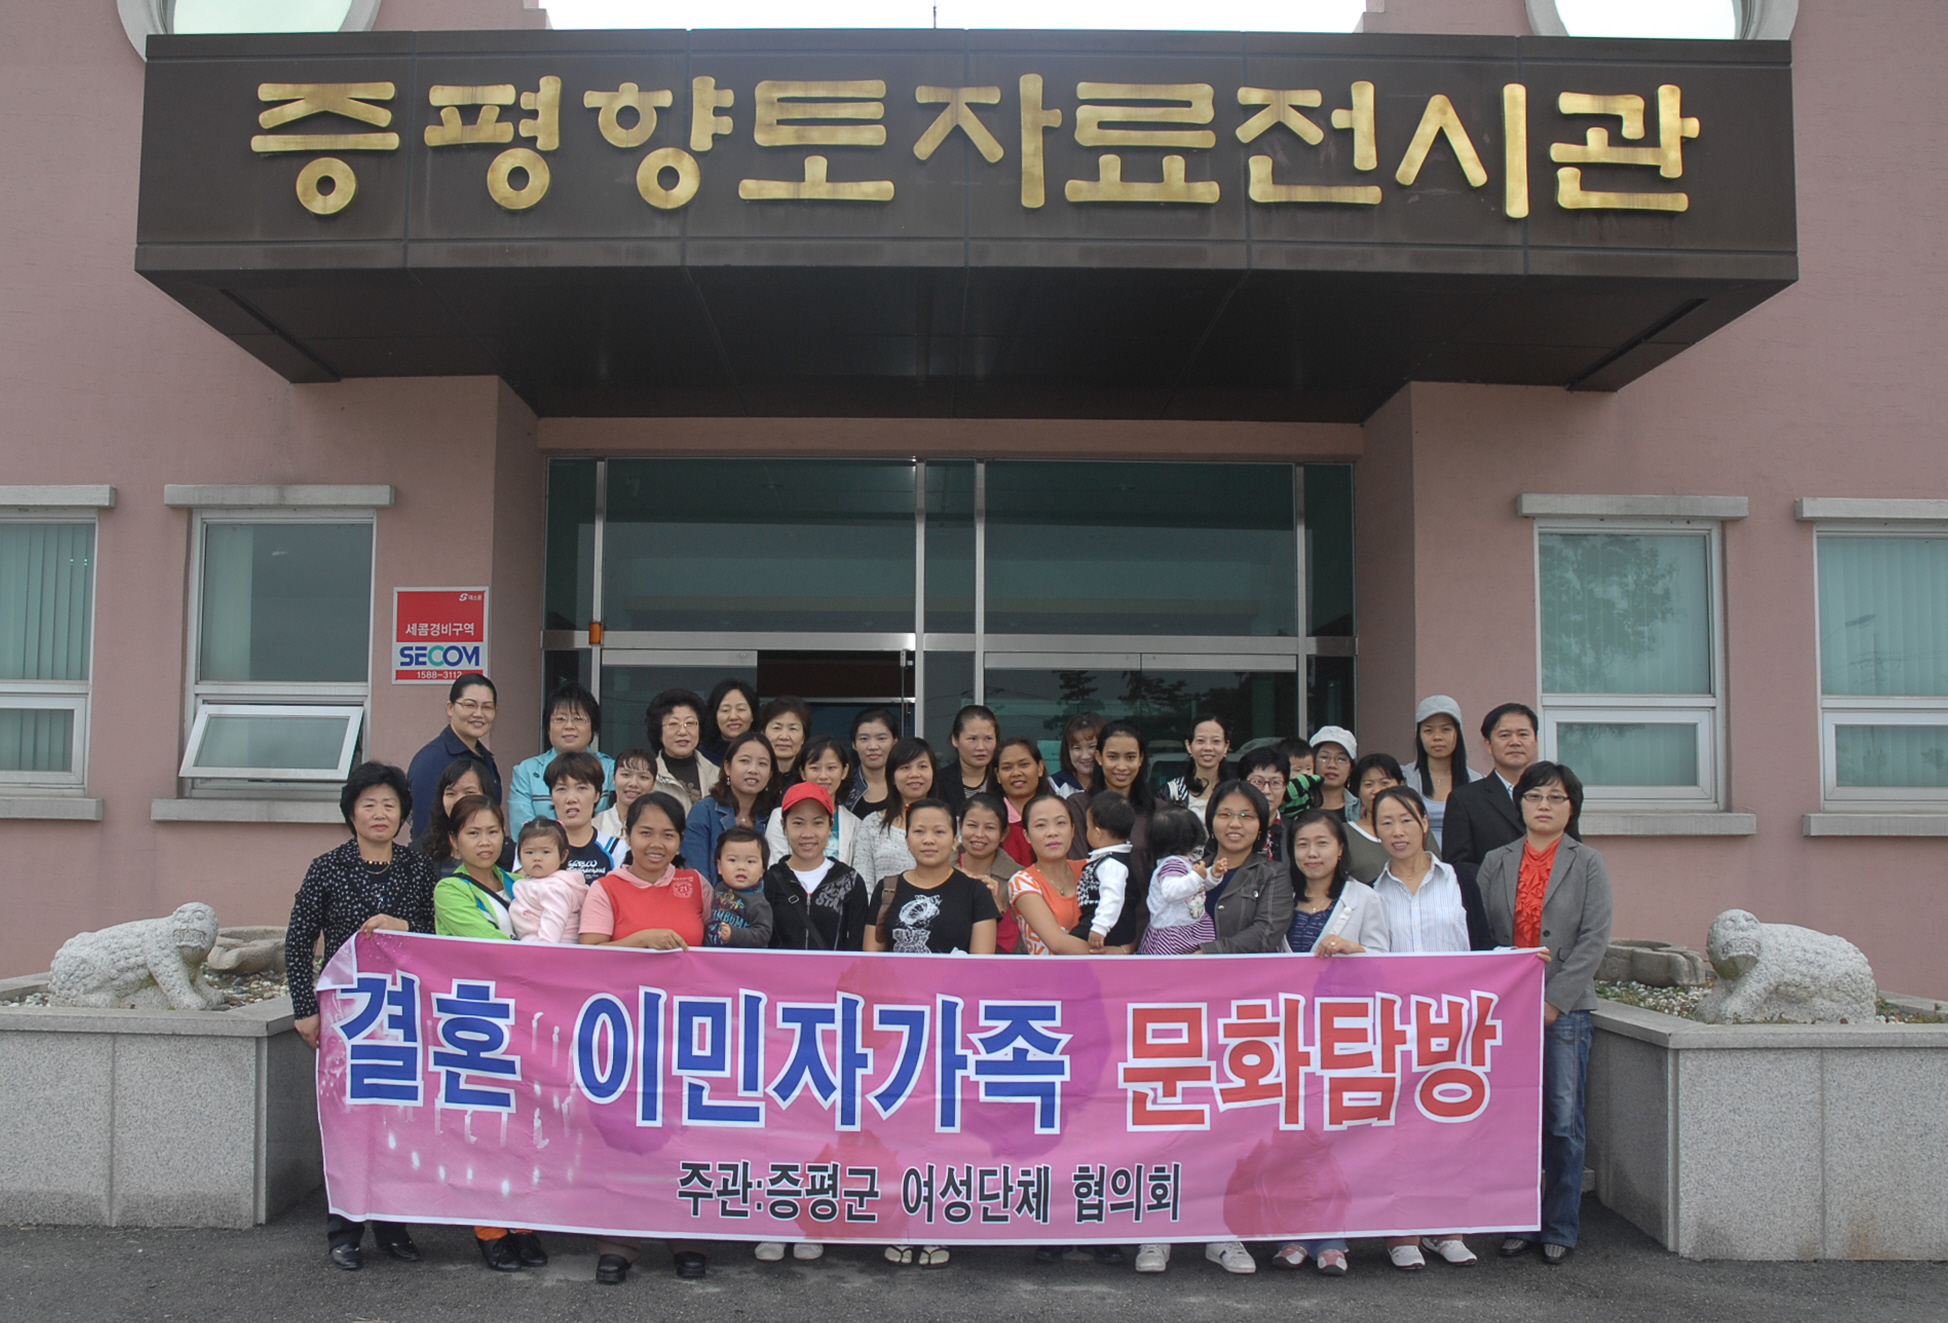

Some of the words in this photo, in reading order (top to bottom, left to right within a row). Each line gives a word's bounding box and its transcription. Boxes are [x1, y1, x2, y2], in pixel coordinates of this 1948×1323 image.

[250, 73, 1702, 219] 증평향토자료전시관
[405, 622, 475, 636] 세콤경비구역
[399, 645, 480, 667] SECOM
[417, 671, 462, 679] 1588-3112
[333, 970, 523, 1114] 결혼
[573, 985, 1074, 1134] 이민자가족
[1118, 989, 1502, 1131] 문화탐방
[677, 1159, 880, 1223] 주관:증평군
[901, 1162, 1051, 1225] 여성단체
[1072, 1161, 1182, 1223] 협의회
